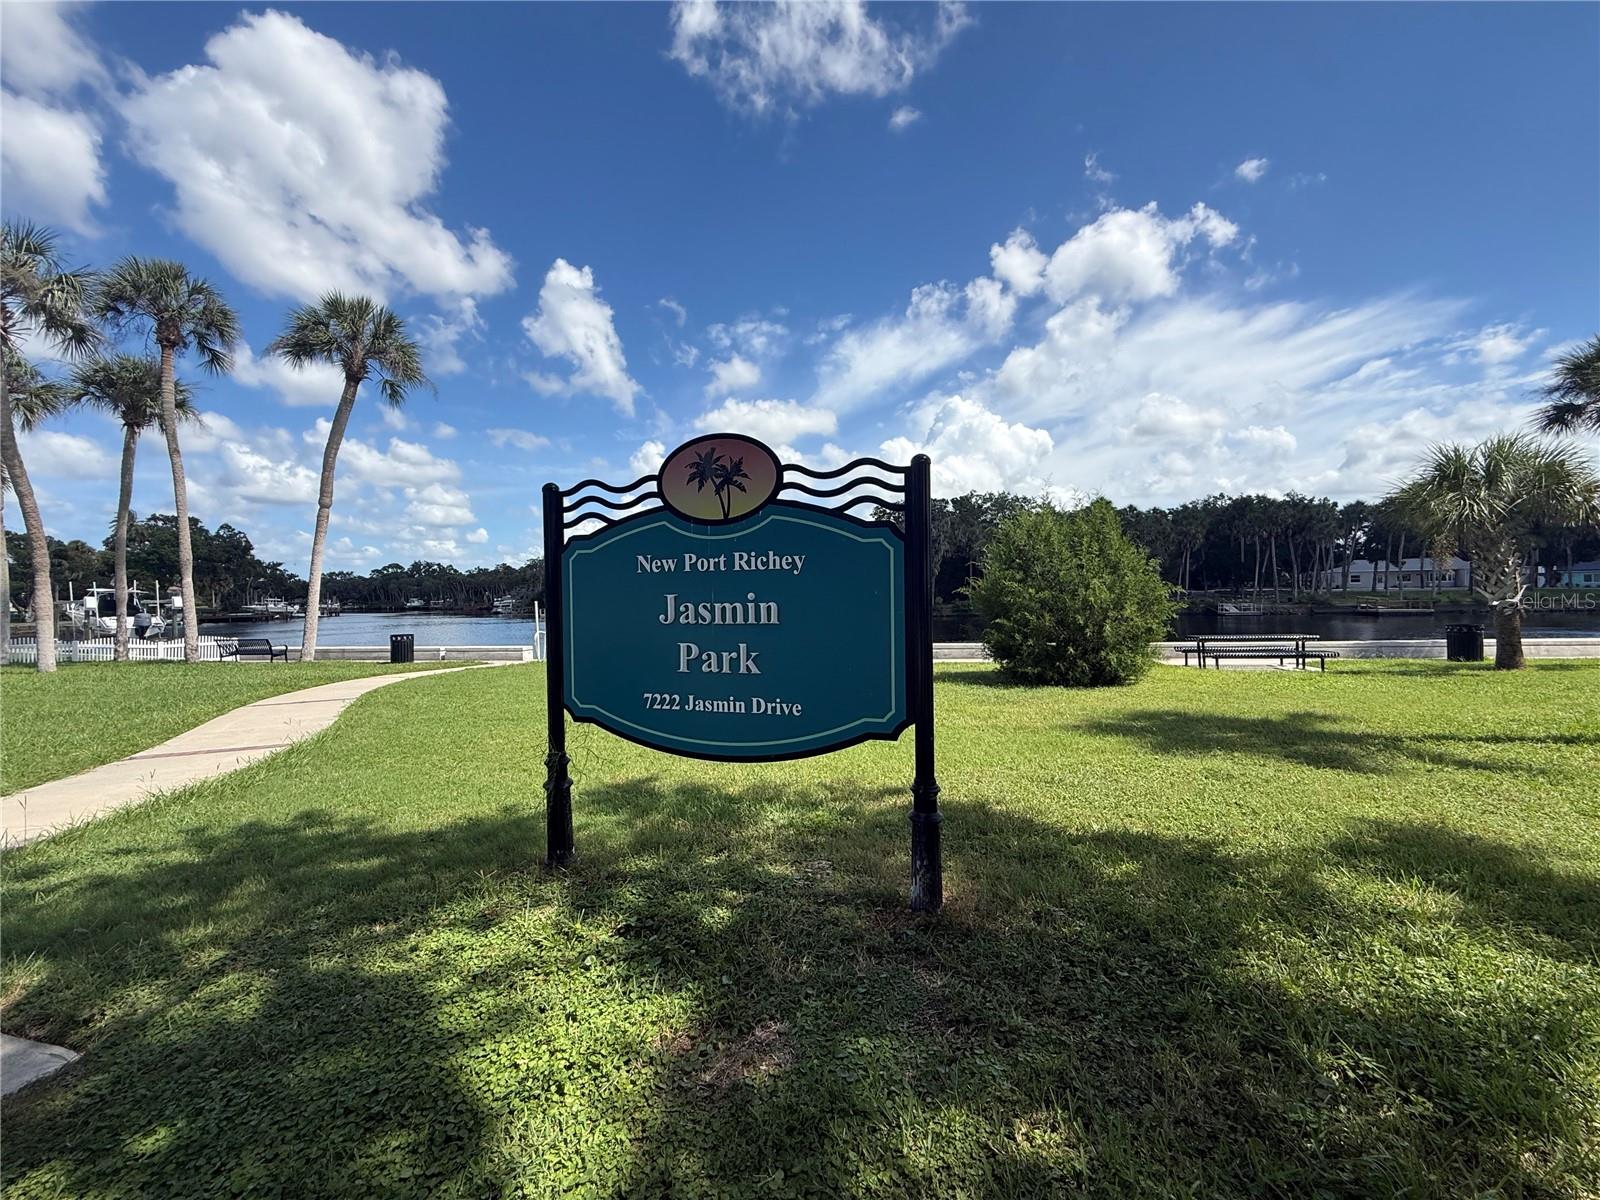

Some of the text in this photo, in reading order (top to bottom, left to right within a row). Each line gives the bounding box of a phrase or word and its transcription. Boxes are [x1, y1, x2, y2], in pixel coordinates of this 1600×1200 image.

[637, 550, 806, 575] New Port Richey
[658, 592, 780, 625] Jasmin
[676, 642, 761, 674] Park
[643, 693, 802, 716] 7222 Jasmin Drive
